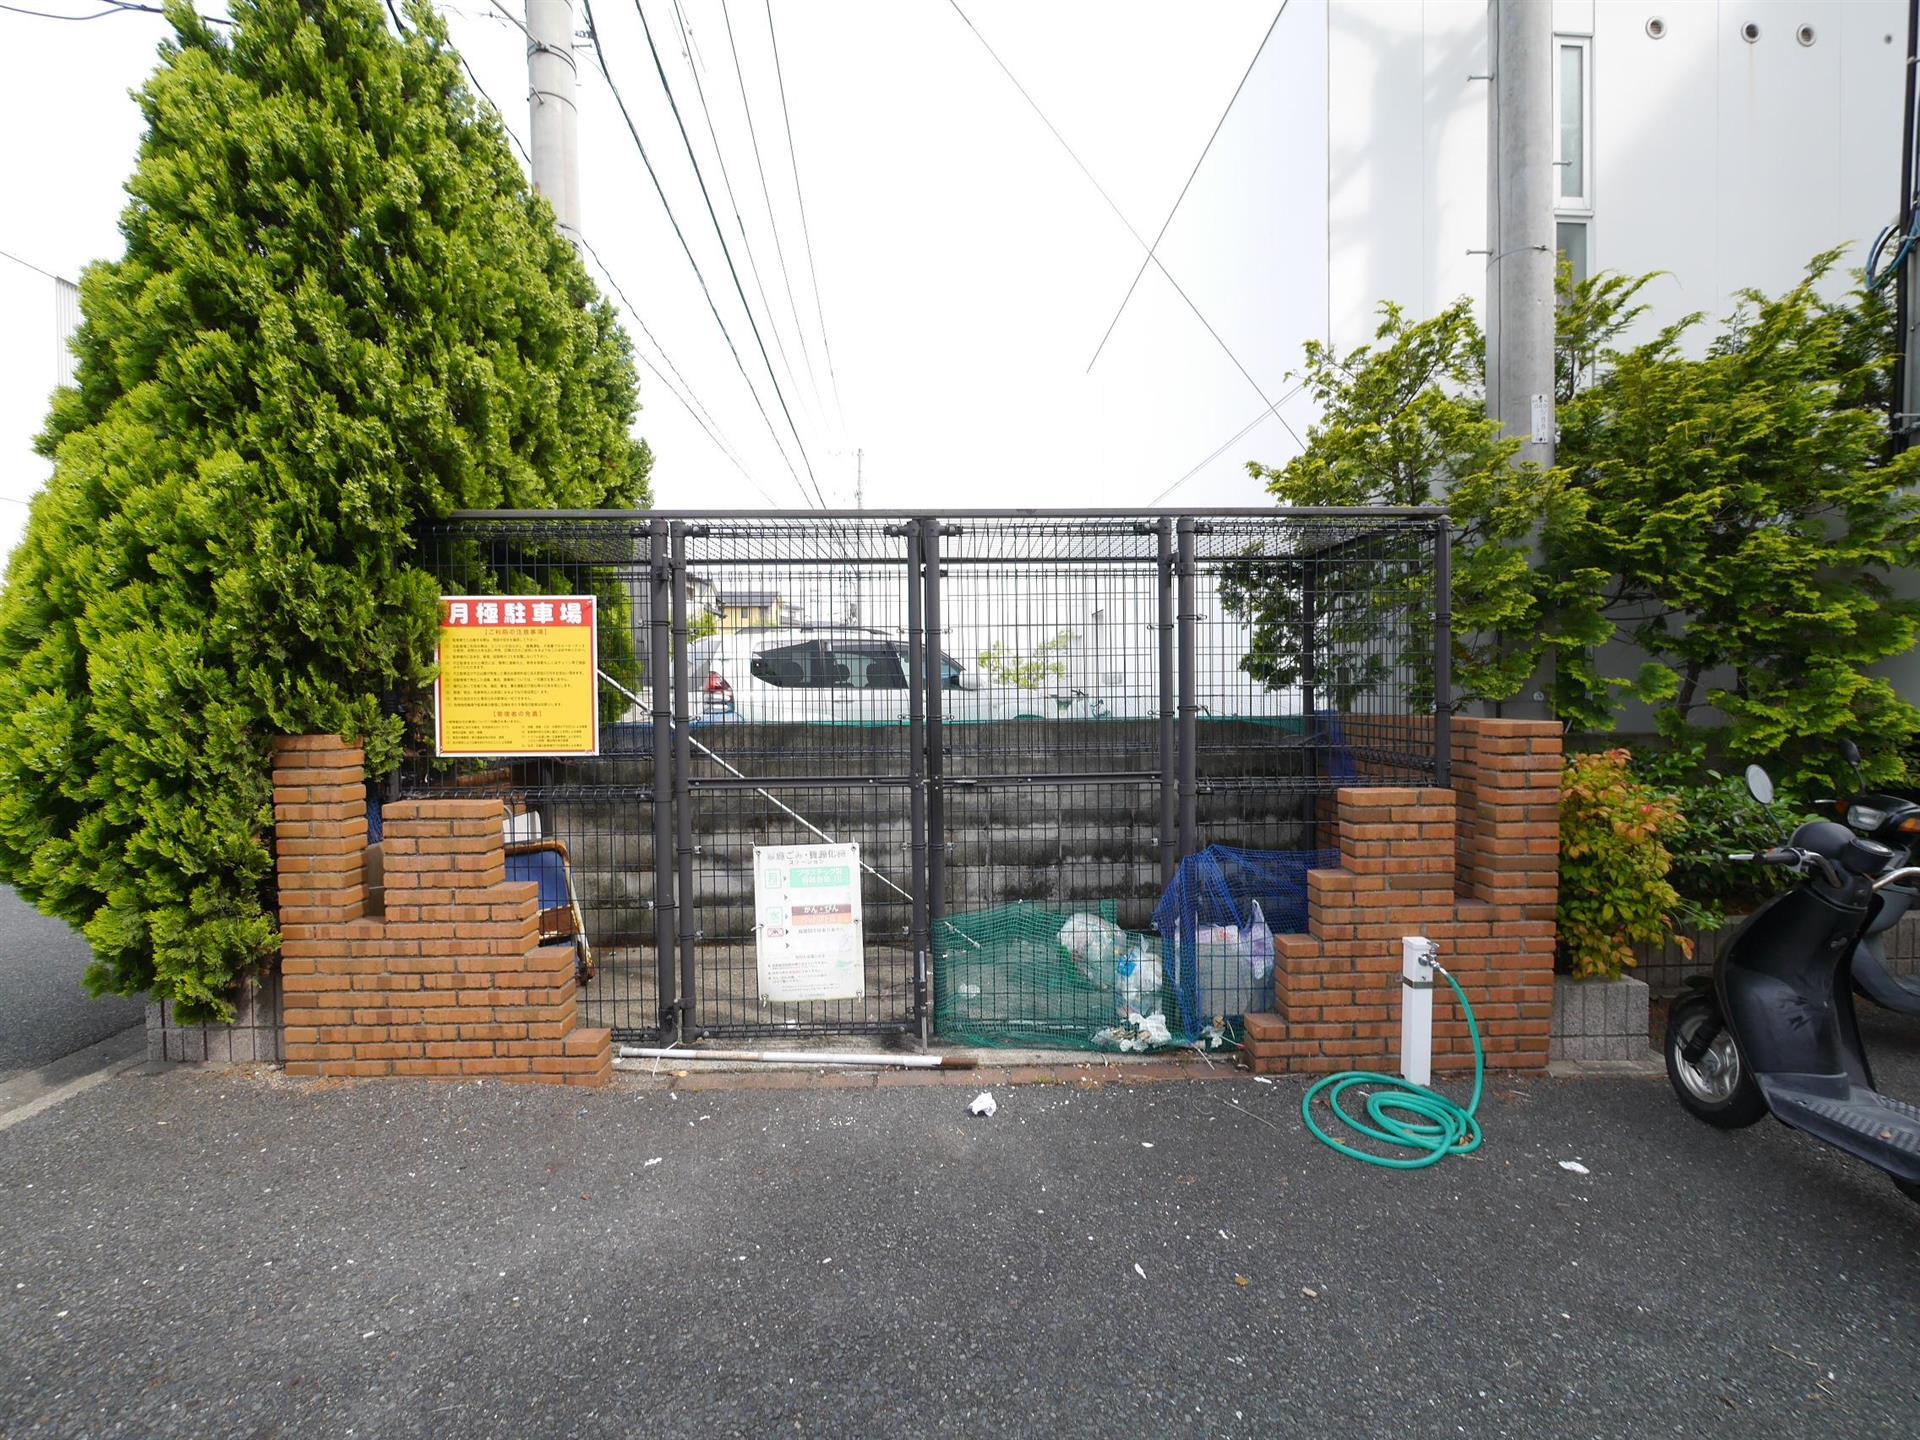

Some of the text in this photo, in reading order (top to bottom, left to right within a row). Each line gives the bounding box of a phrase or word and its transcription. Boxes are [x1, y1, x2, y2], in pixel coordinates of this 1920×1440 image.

[449, 602, 583, 624] 月極駐車場
[803, 905, 839, 913] かん・びん
